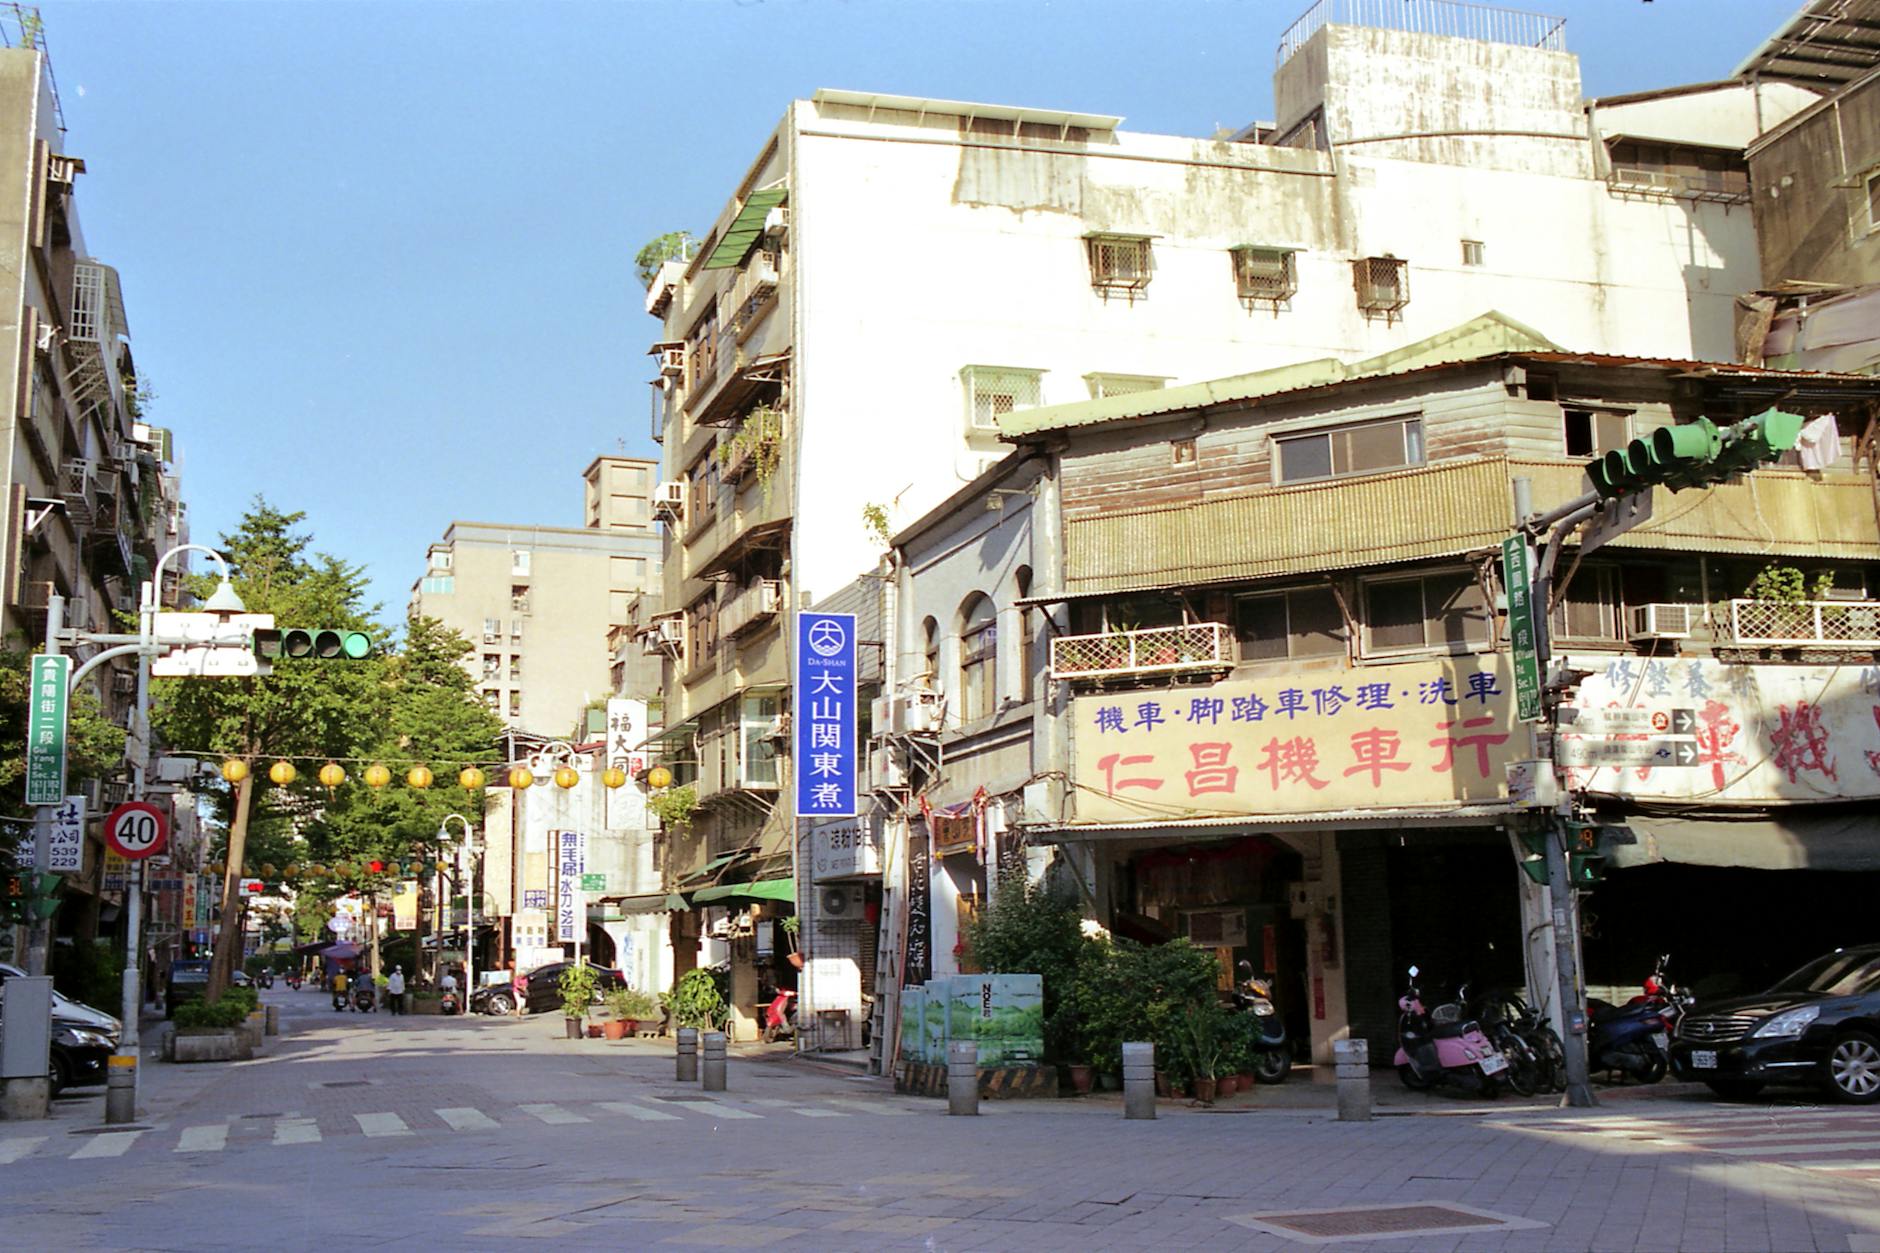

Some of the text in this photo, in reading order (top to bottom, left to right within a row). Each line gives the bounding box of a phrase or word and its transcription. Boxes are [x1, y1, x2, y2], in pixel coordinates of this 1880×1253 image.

[40, 668, 57, 744] 貴陽街二段
[1096, 716, 1510, 799] 仁昌機車行
[118, 816, 156, 844] 40
